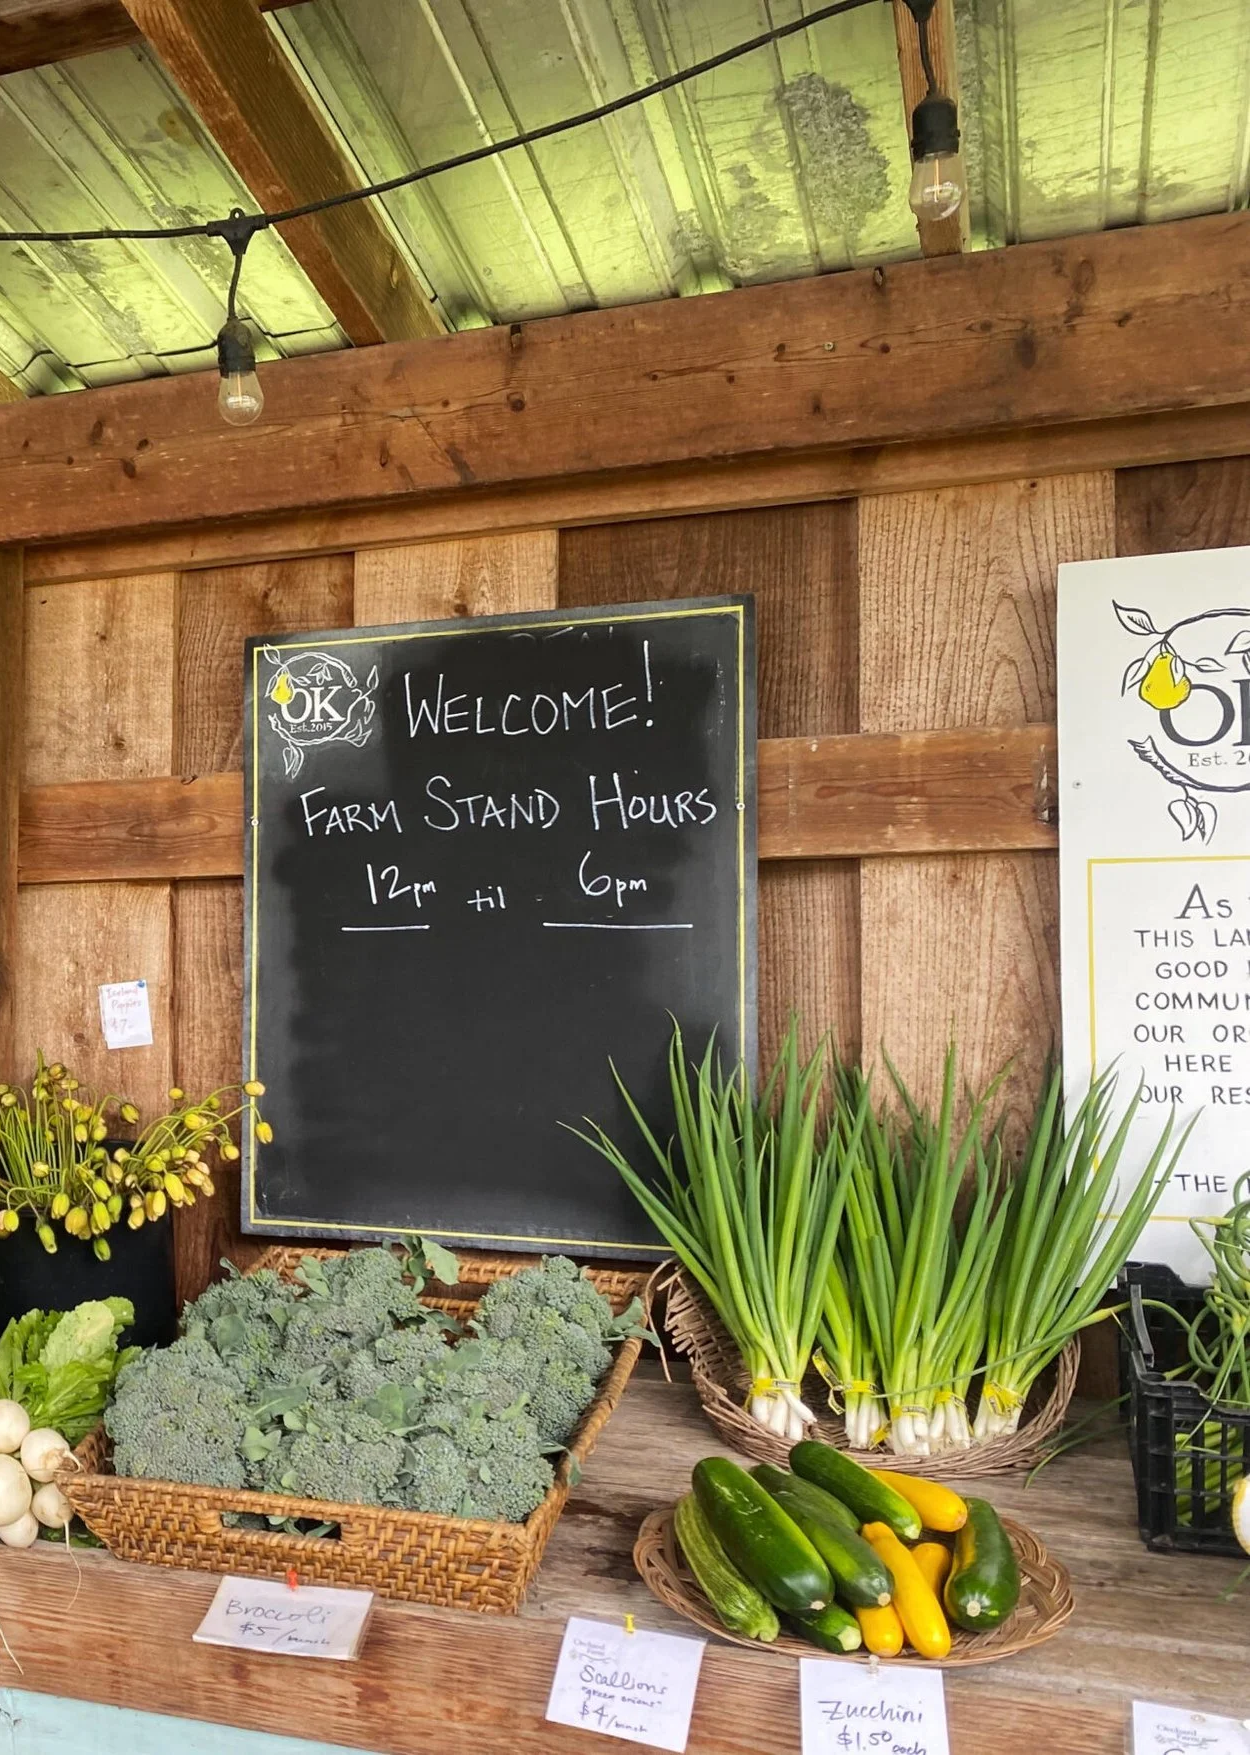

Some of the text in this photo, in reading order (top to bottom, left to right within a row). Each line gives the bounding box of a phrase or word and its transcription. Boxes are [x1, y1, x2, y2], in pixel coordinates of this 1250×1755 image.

[403, 639, 655, 738] WELCOME!
[280, 685, 346, 723] OK
[1187, 752, 1228, 767] Est.
[299, 771, 718, 837] FARM STAND HOURS
[366, 863, 438, 909] 12pm
[578, 850, 649, 908] 6pm
[1174, 883, 1233, 920] As
[1133, 929, 1195, 948] THIS
[1155, 960, 1229, 980] GOOD
[1133, 1023, 1250, 1043] OUR OR
[1164, 1053, 1233, 1073] HERE
[1139, 1084, 1184, 1104] OUR
[225, 1598, 332, 1625] Broccoli
[579, 1664, 668, 1695] Scallions
[817, 1700, 924, 1723] Zucchini
